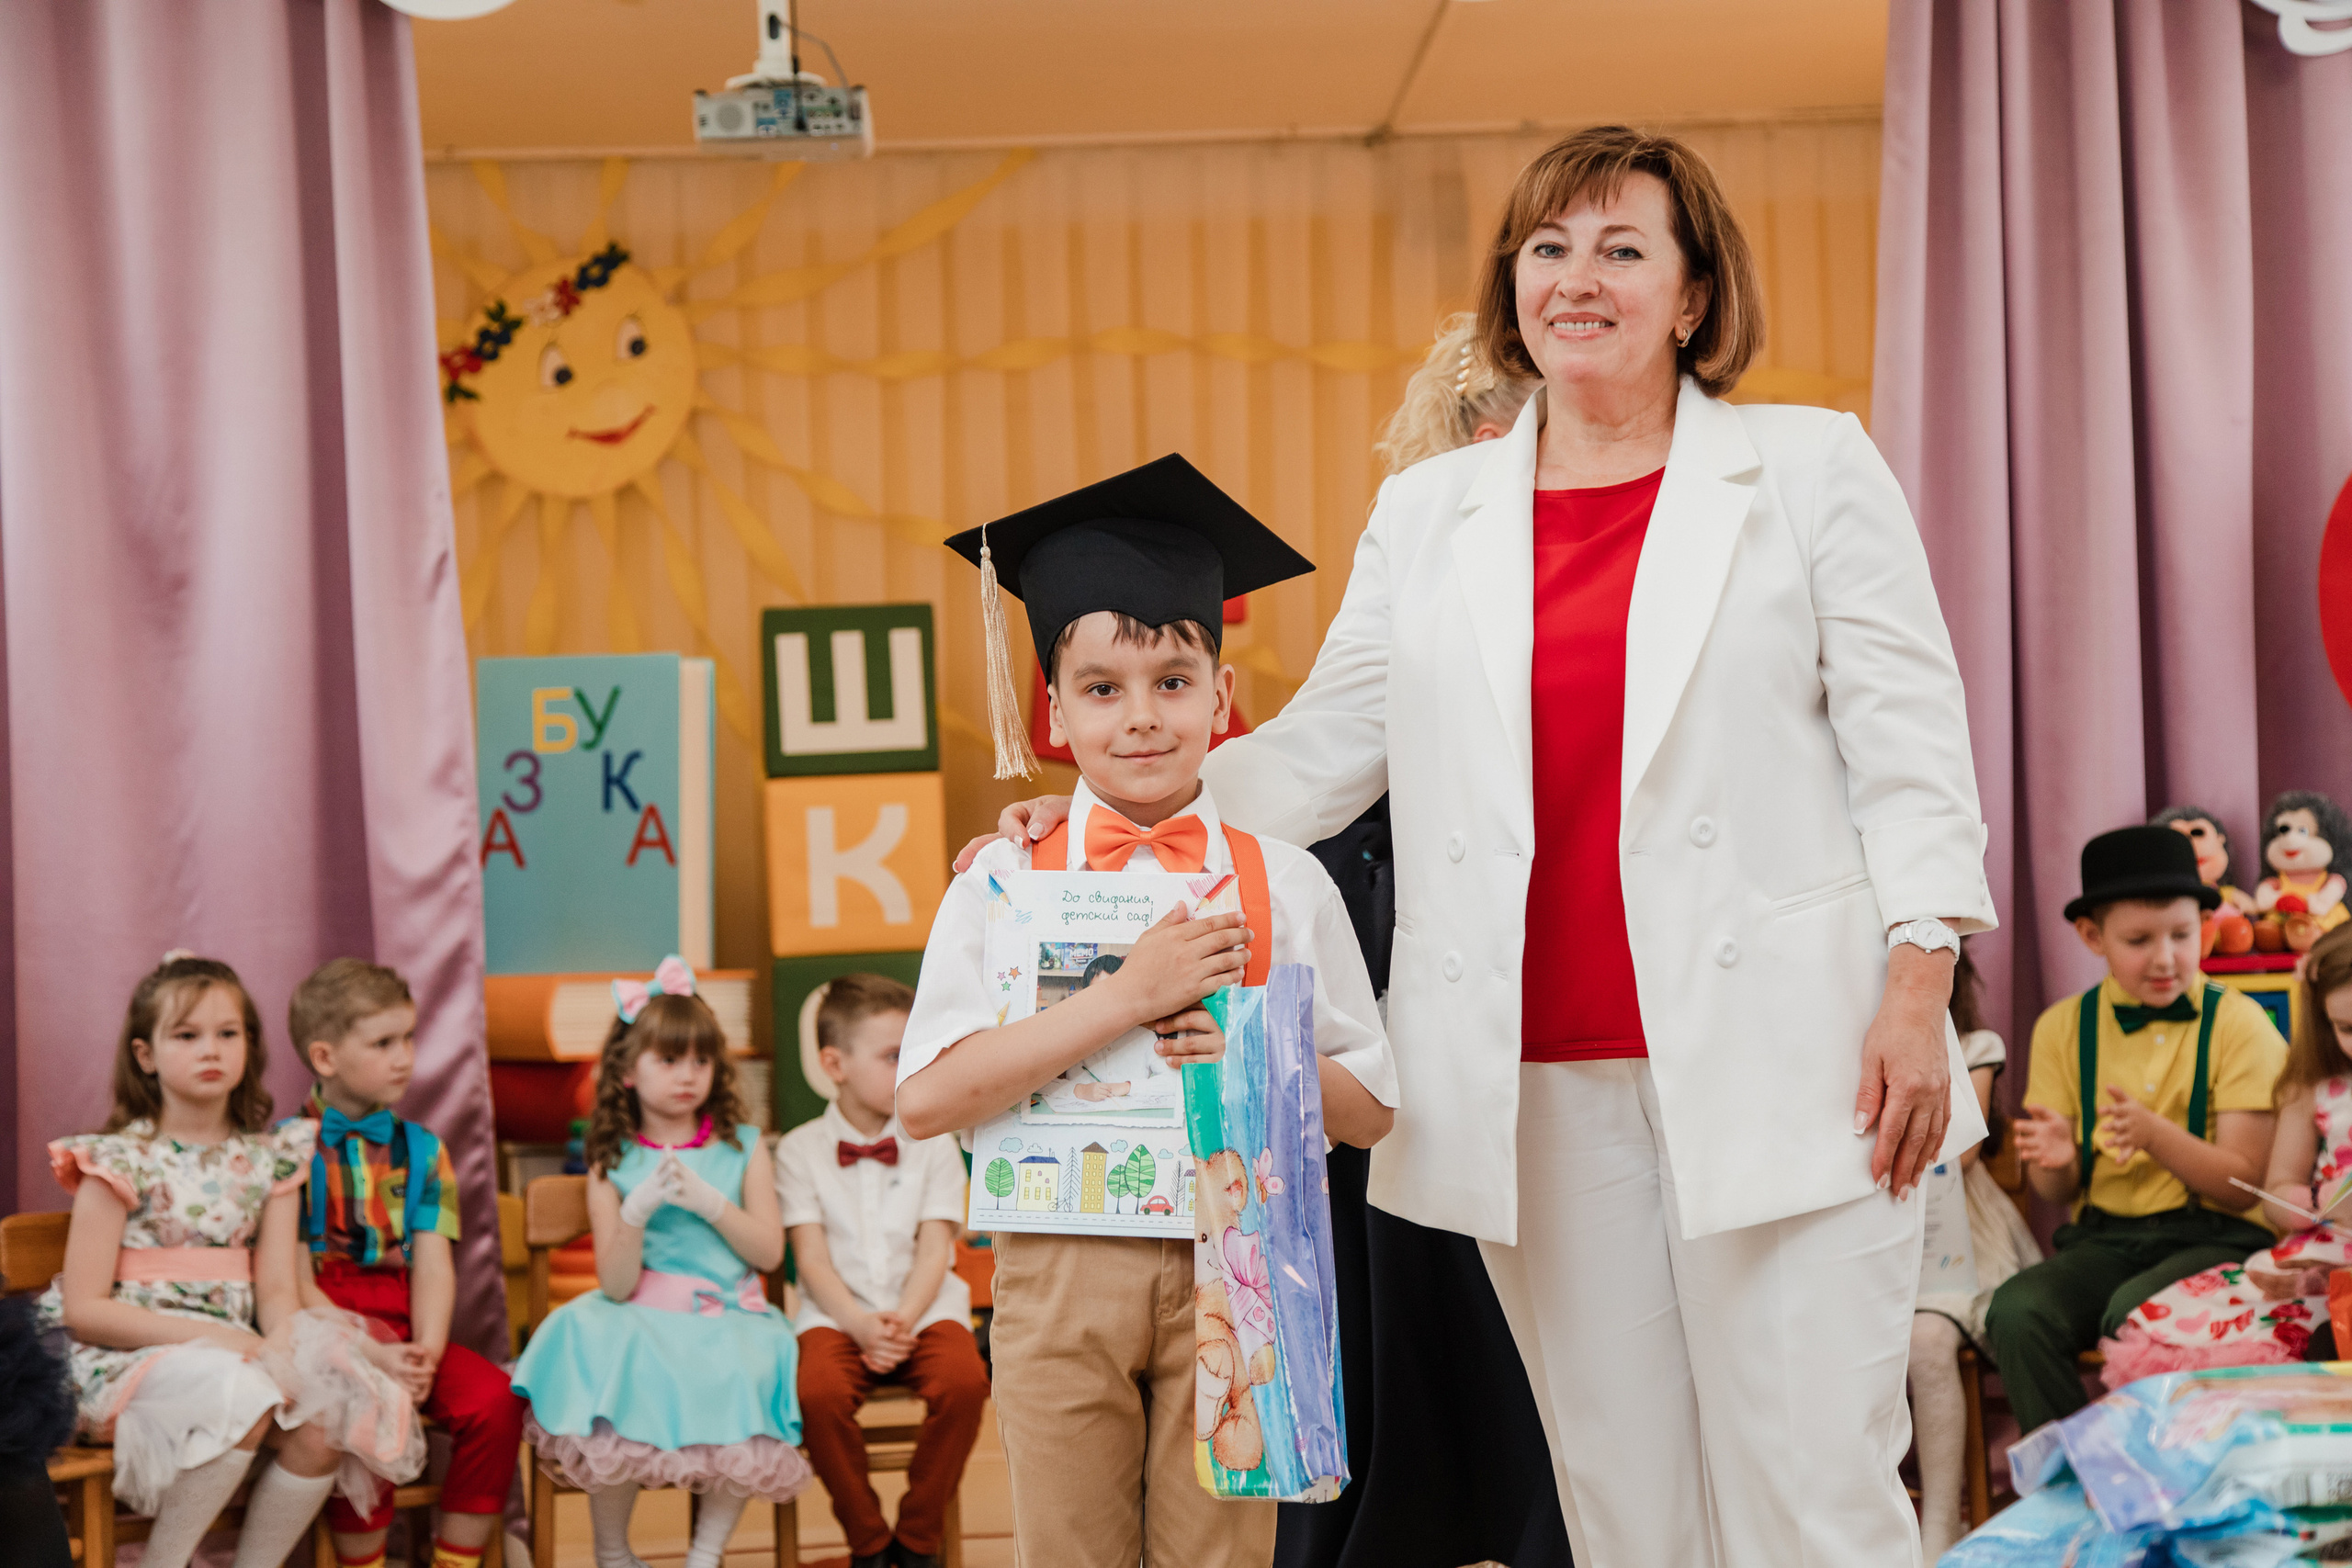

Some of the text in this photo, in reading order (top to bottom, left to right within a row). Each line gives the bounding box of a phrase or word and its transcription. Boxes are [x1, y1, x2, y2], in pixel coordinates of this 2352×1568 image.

[1062, 890, 1153, 908] До свидания,
[1061, 908, 1153, 927] детский сад!
